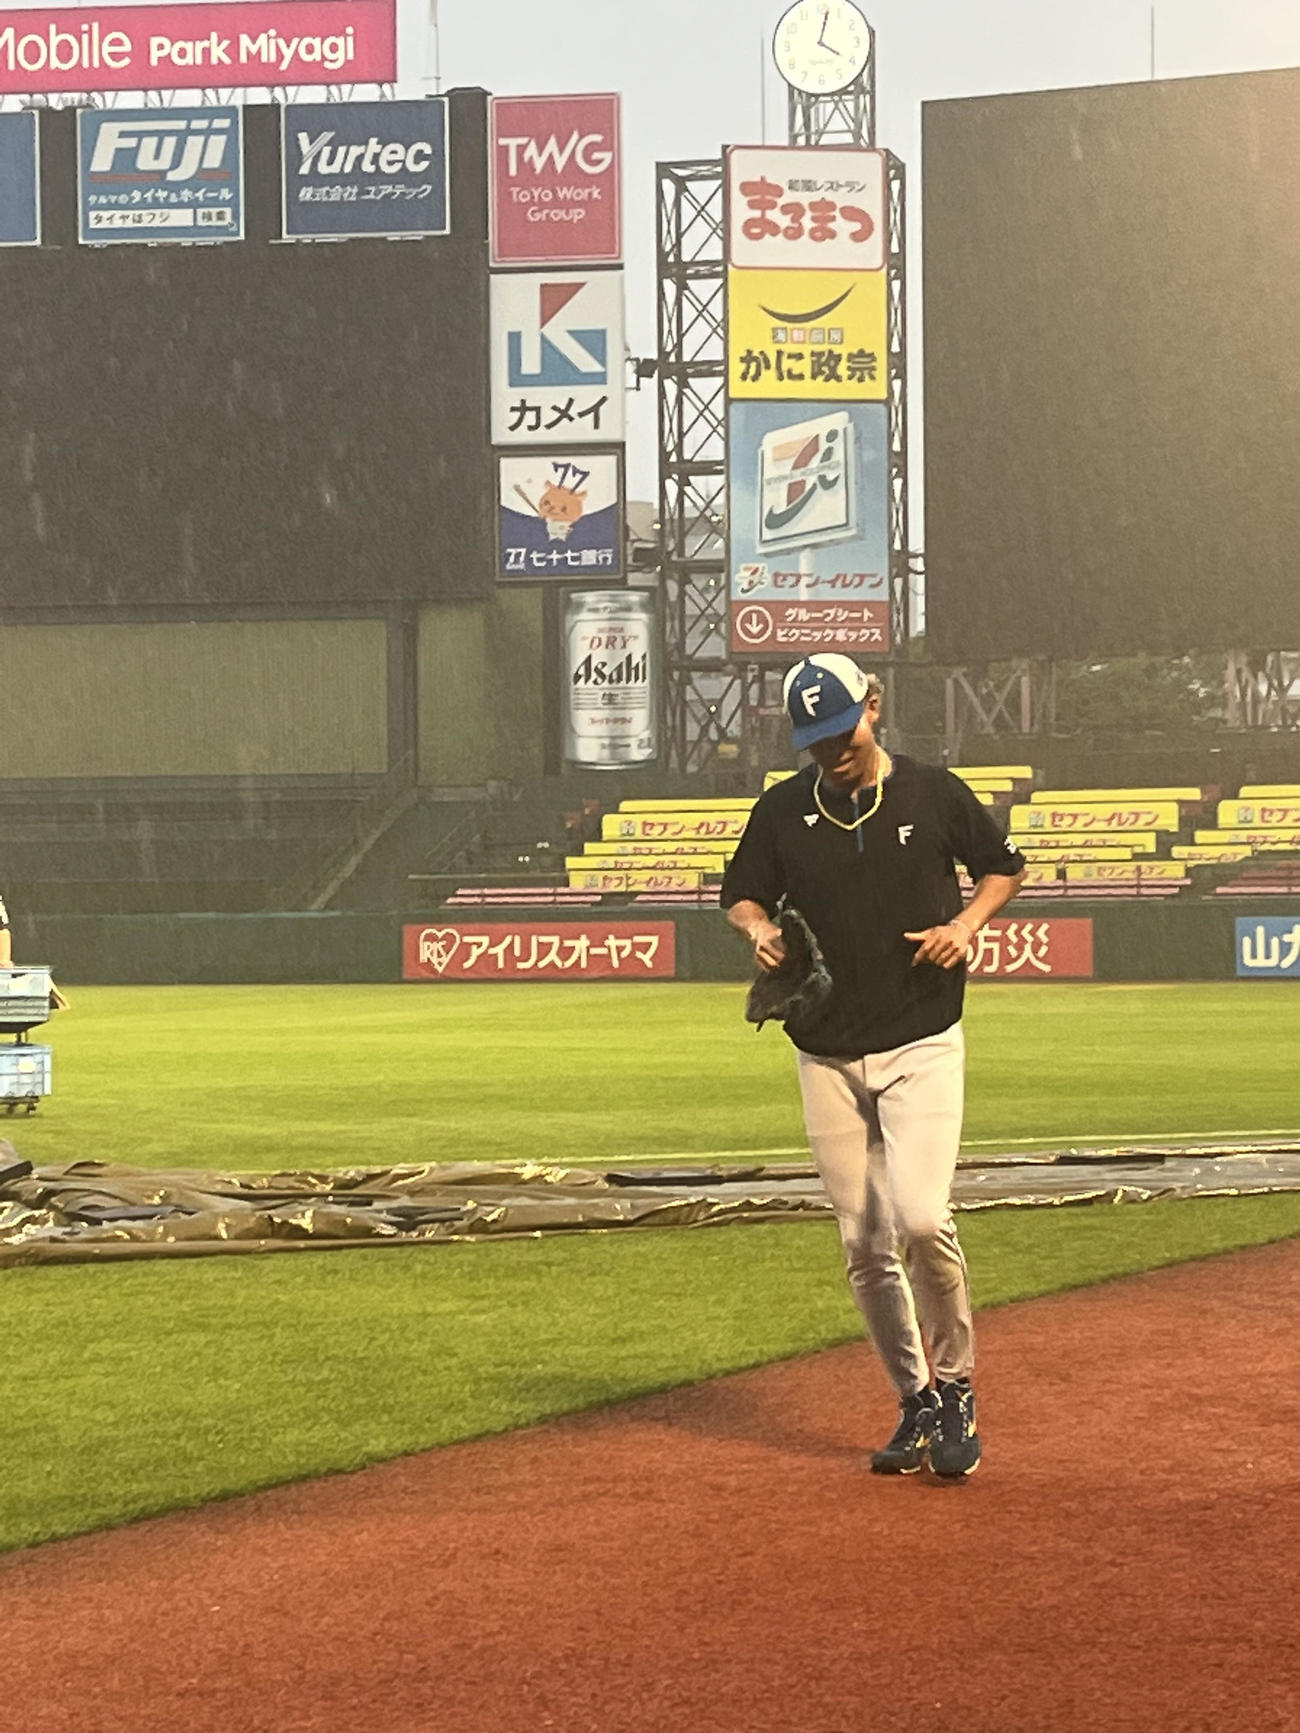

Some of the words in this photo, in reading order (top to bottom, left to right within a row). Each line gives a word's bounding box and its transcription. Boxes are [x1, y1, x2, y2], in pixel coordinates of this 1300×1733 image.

[150, 32, 232, 67] Park
[240, 26, 355, 71] Miyagi
[90, 118, 231, 181] Fuji
[297, 131, 433, 175] Yurtec
[498, 129, 614, 177] TWG
[361, 184, 433, 201] ユアテック
[556, 184, 602, 200] Work
[527, 205, 586, 223] Group
[739, 176, 875, 244] まるまつ
[740, 349, 877, 384] かに政宗
[508, 395, 609, 432] カメイ
[551, 461, 590, 495] 77
[785, 607, 874, 623] グループシート
[776, 627, 883, 643] ピクニックボックス
[573, 652, 648, 686] Asahi
[801, 685, 822, 717] F
[898, 824, 914, 846] F
[462, 934, 659, 969] アイリスオーヤマ
